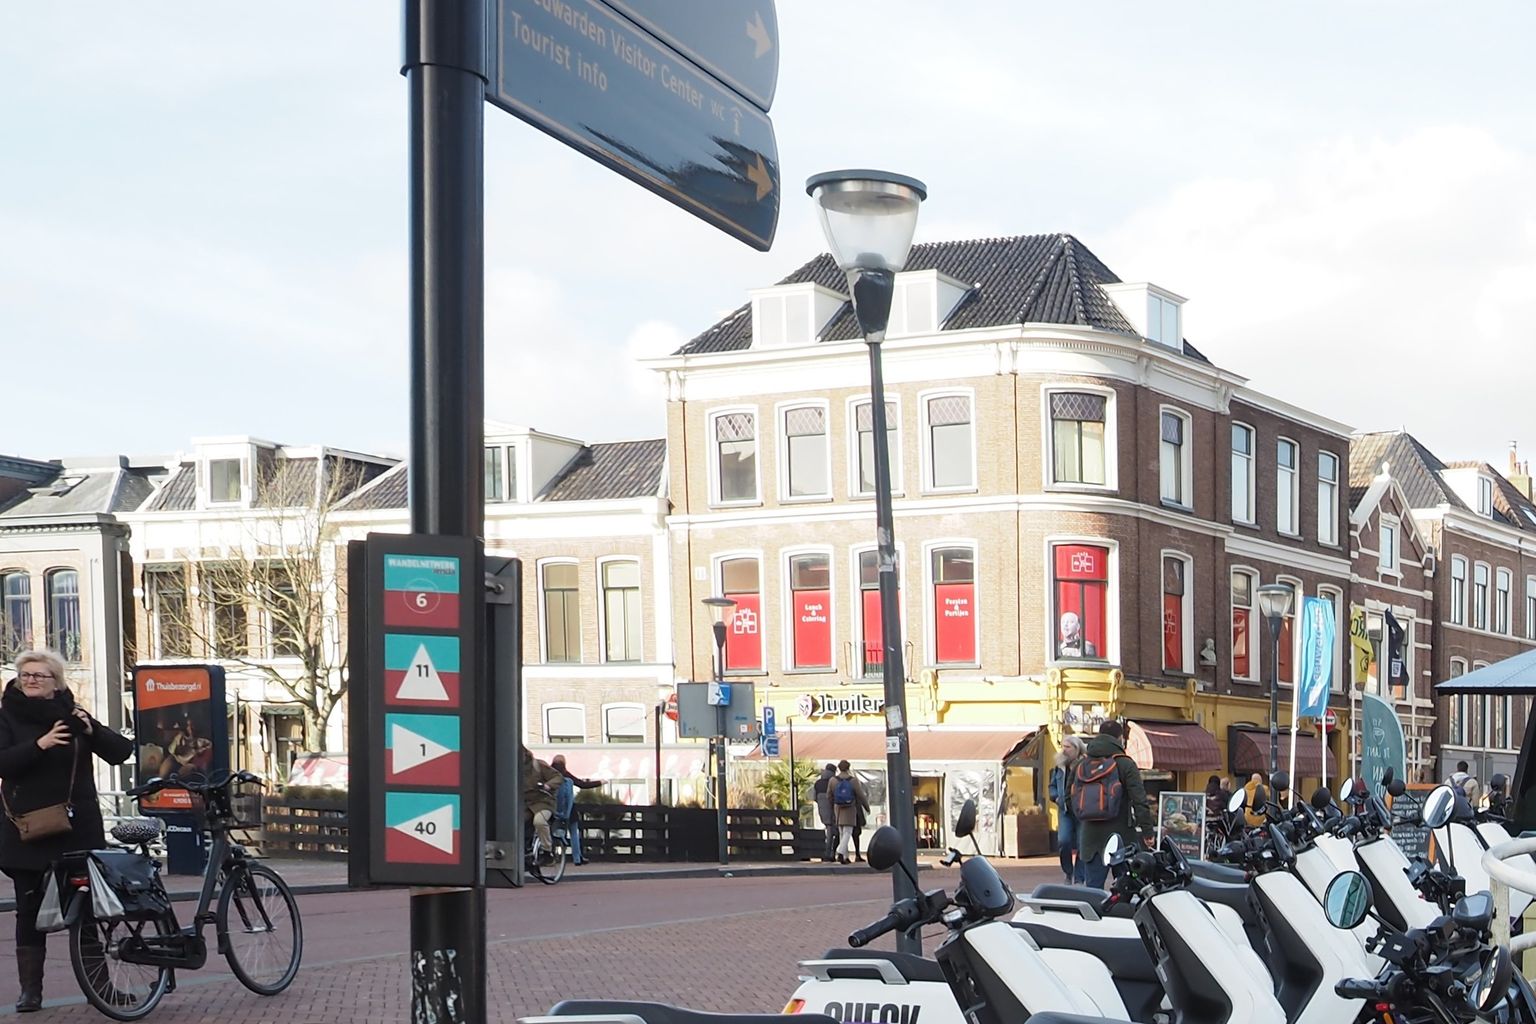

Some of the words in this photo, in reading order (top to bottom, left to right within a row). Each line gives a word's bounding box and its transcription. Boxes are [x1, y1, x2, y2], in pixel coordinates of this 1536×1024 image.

[511, 11, 571, 71] Tourist
[577, 53, 608, 91] info
[533, 0, 606, 47] uwarden
[611, 29, 657, 79] Visitor
[661, 64, 703, 107] Center
[416, 593, 427, 608] 6
[415, 664, 430, 678] 11
[816, 693, 884, 716] Jupiler
[420, 744, 426, 757] 1
[414, 822, 436, 836] 40
